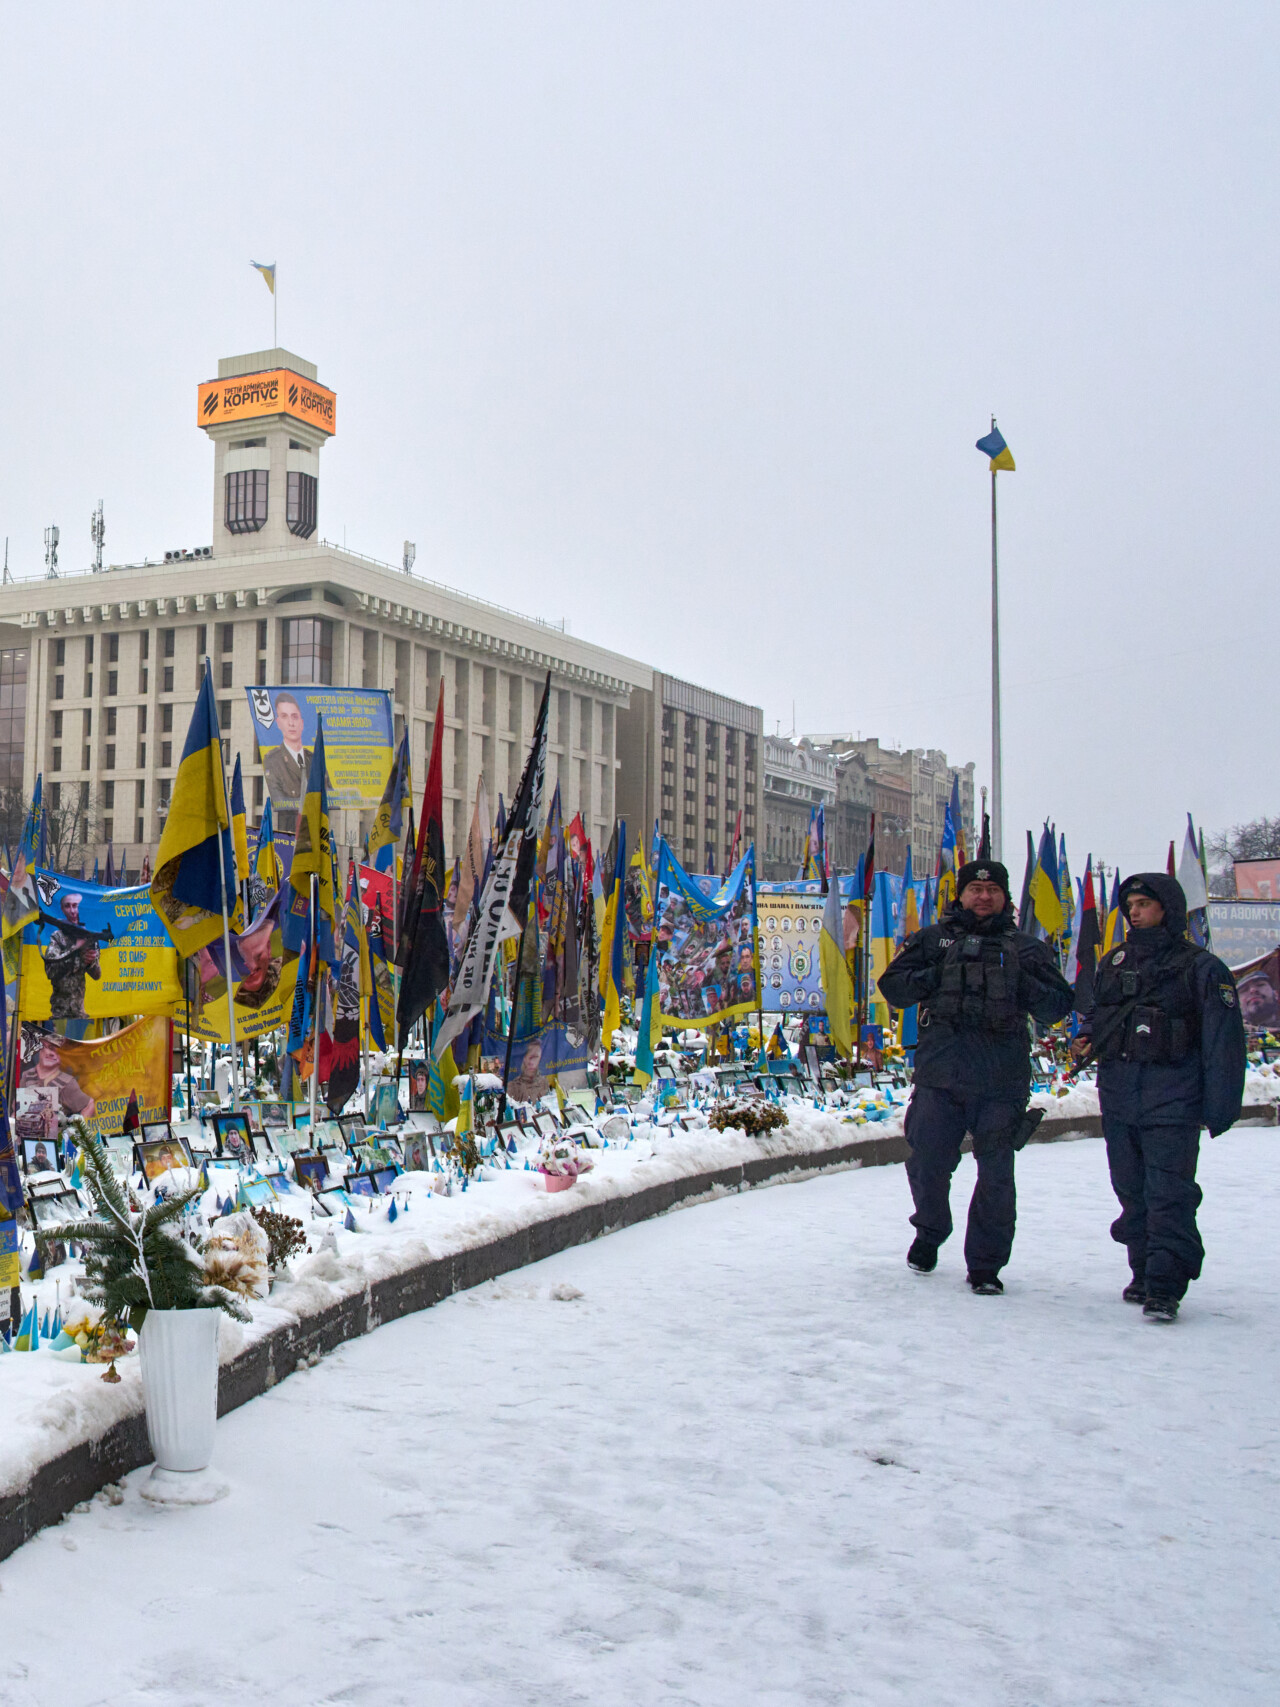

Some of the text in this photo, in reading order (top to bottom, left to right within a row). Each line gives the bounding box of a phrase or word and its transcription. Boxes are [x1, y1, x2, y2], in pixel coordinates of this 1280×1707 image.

[224, 378, 278, 396] ТРЕТІЙ АРМІЙСЬКИЙ
[224, 388, 278, 407] КОРПУС
[301, 394, 332, 419] КОРПУС
[119, 967, 144, 978] ЗАГИНУВ
[137, 981, 162, 992] БАХМУТ
